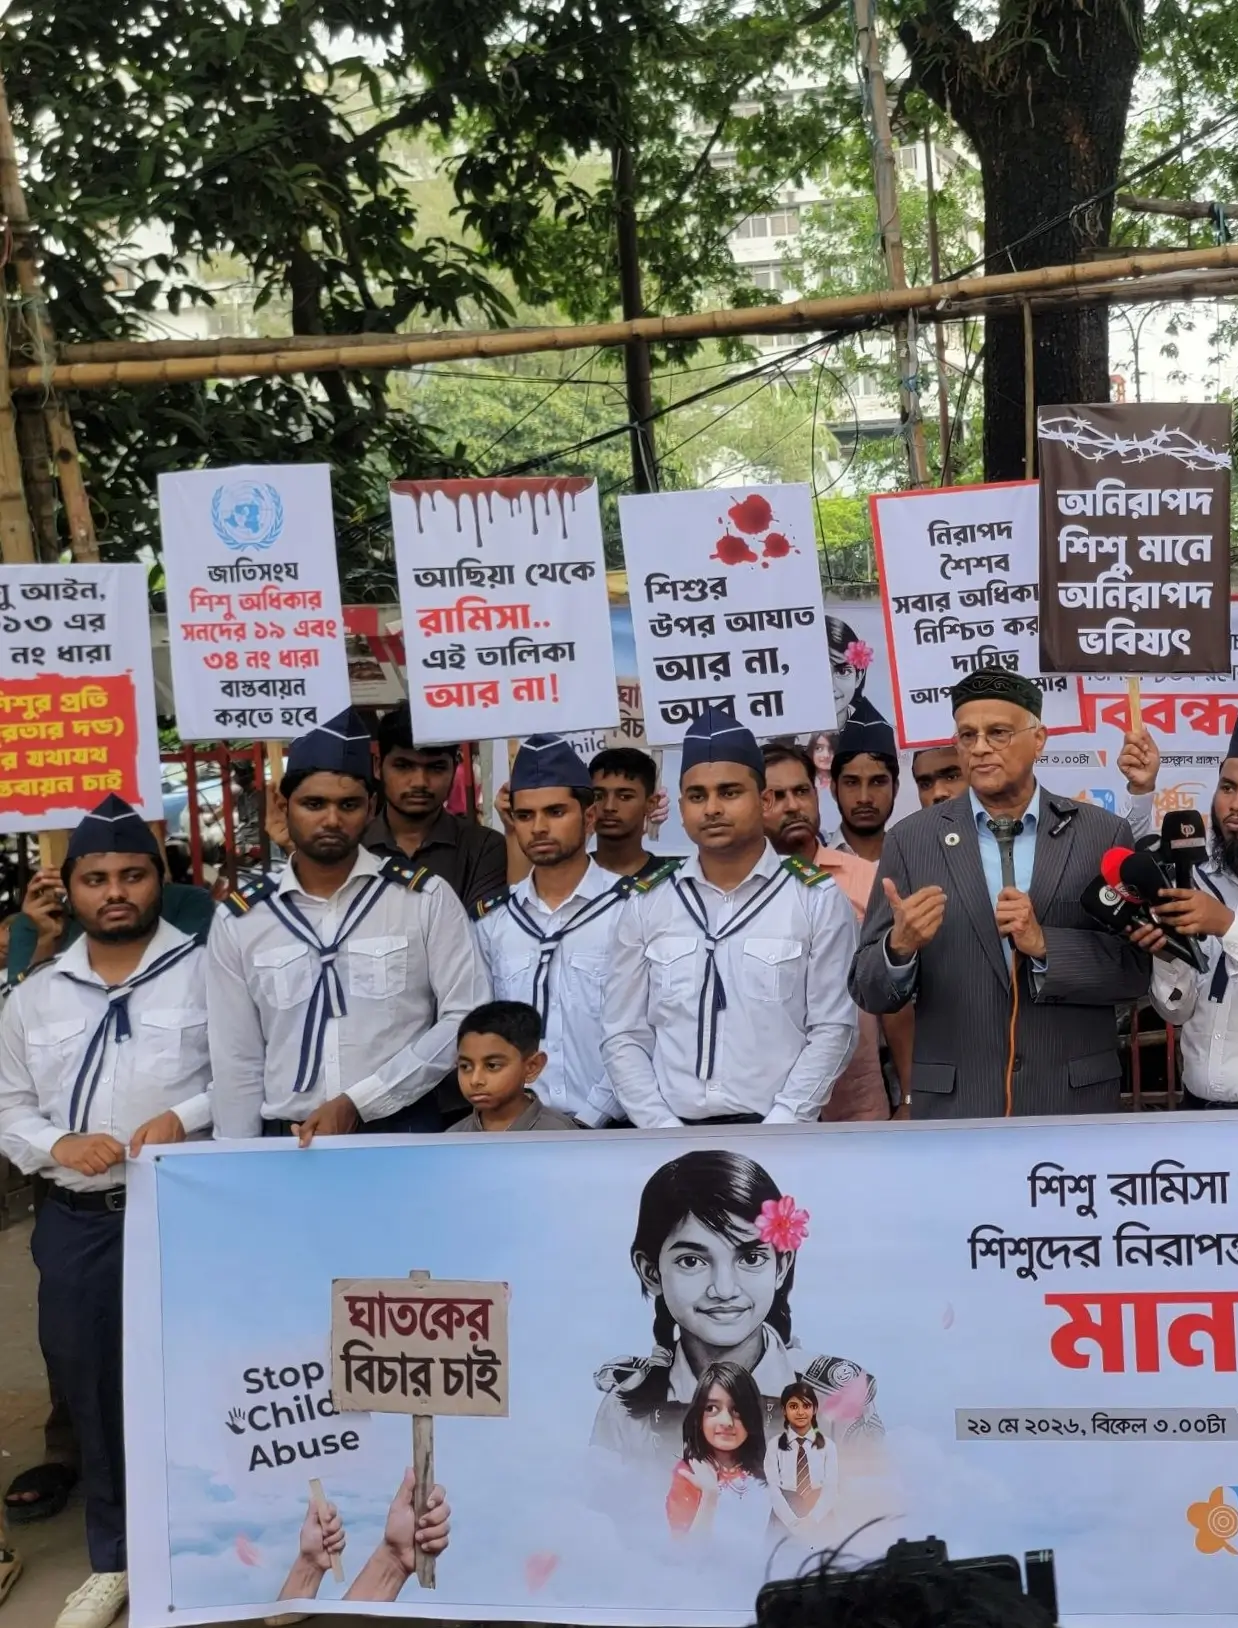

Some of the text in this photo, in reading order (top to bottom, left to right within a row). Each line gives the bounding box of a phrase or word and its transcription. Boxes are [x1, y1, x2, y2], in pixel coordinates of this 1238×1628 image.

[1057, 477, 1214, 519] অনিরাপদ
[928, 519, 1012, 548] নিরাপদ
[1058, 524, 1212, 576] শিশু মানে
[207, 559, 300, 585] জাতিসংঘ
[414, 557, 596, 590] আছিয়া থেকে
[940, 554, 1010, 580] শৈশব
[19, 578, 106, 601] আইন,
[190, 586, 323, 619] শিশু অধিকার
[645, 572, 727, 605] শিশুর
[893, 581, 1040, 615] সবার অধিকা
[1058, 570, 1213, 612] অনিরাপদ
[64, 614, 105, 633] এর
[180, 617, 337, 643] সনদের ১৯ এবং
[417, 596, 551, 641] রামিসা..
[650, 605, 815, 640] উপর আঘাত
[914, 615, 995, 646] নিশ্চিত
[424, 636, 576, 671] এই তালিকা
[1078, 617, 1191, 658] ভবিষ্যৎ
[9, 645, 112, 666] নং ধারা
[202, 647, 319, 671] ৩৪ নং ধারা
[655, 646, 790, 686] আর না,
[60, 684, 108, 713] প্রতি
[220, 676, 306, 701] বাস্তবায়ন
[424, 680, 501, 711] আর
[511, 672, 559, 706] না!
[749, 690, 785, 719] না
[213, 704, 317, 729] করতে হবে
[26, 747, 108, 767] যথাযথ
[569, 731, 608, 753] hild
[81, 768, 122, 792] চাই
[1028, 1162, 1097, 1218] শিশু
[1111, 1160, 1229, 1209] রামিসা
[968, 1225, 1102, 1281] শিশুদের
[344, 1291, 494, 1344] ঘাতকের
[243, 1361, 324, 1394] Stop
[340, 1341, 502, 1401] বিচার চাই
[967, 1412, 1226, 1436] ২১ মে ২০২৬, বিকেল ৩.০০টা
[248, 1429, 360, 1471] Abuse
